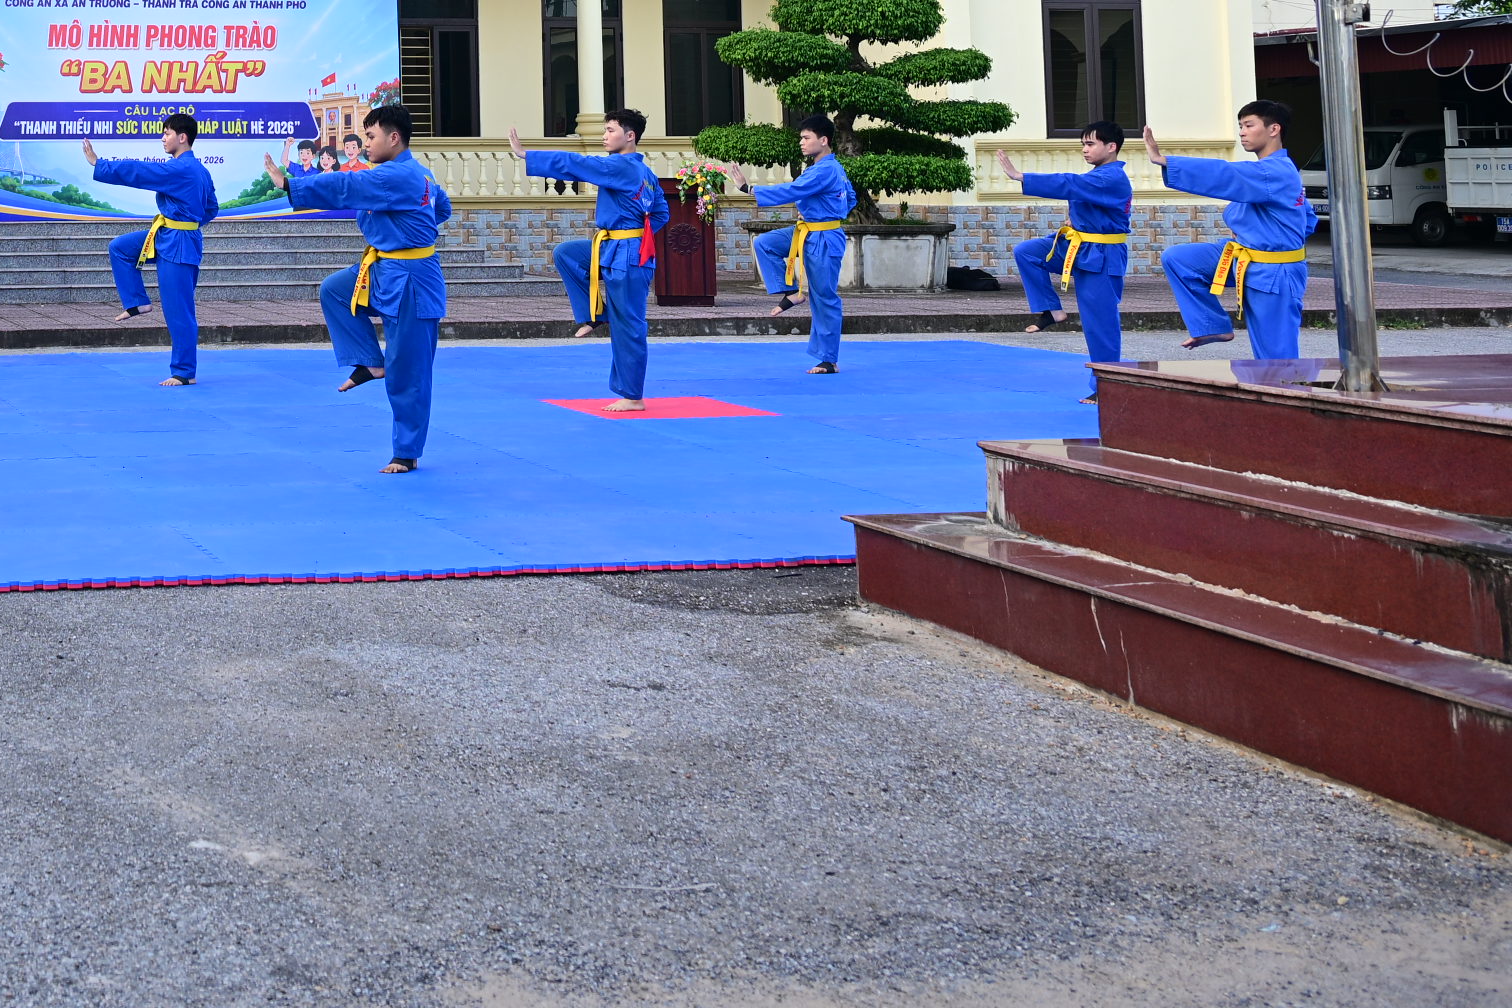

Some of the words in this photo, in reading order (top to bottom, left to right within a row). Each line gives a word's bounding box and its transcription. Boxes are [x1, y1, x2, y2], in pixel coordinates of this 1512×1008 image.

[72, 0, 86, 8] AN
[142, 0, 176, 9] THANH
[179, 0, 199, 9] TRA
[232, 0, 247, 9] AN
[48, 20, 82, 48] MÔ
[88, 20, 139, 48] HÌNH
[145, 24, 217, 49] PHONG
[224, 20, 277, 49] TRÀO
[60, 59, 133, 93] “BA
[141, 51, 266, 93] NHẤT”
[124, 105, 149, 116] CÂU
[152, 106, 175, 118] LẠC
[14, 120, 57, 135] “THANH
[60, 117, 90, 135] THIẾU
[94, 121, 113, 135] NHI
[116, 118, 138, 135] SỨC
[141, 117, 164, 135] KHỎ
[197, 119, 218, 135] HÁP
[222, 118, 248, 137] LUẬT
[251, 119, 265, 135] HÈ
[267, 121, 301, 135] 2026”
[203, 156, 224, 164] 2026
